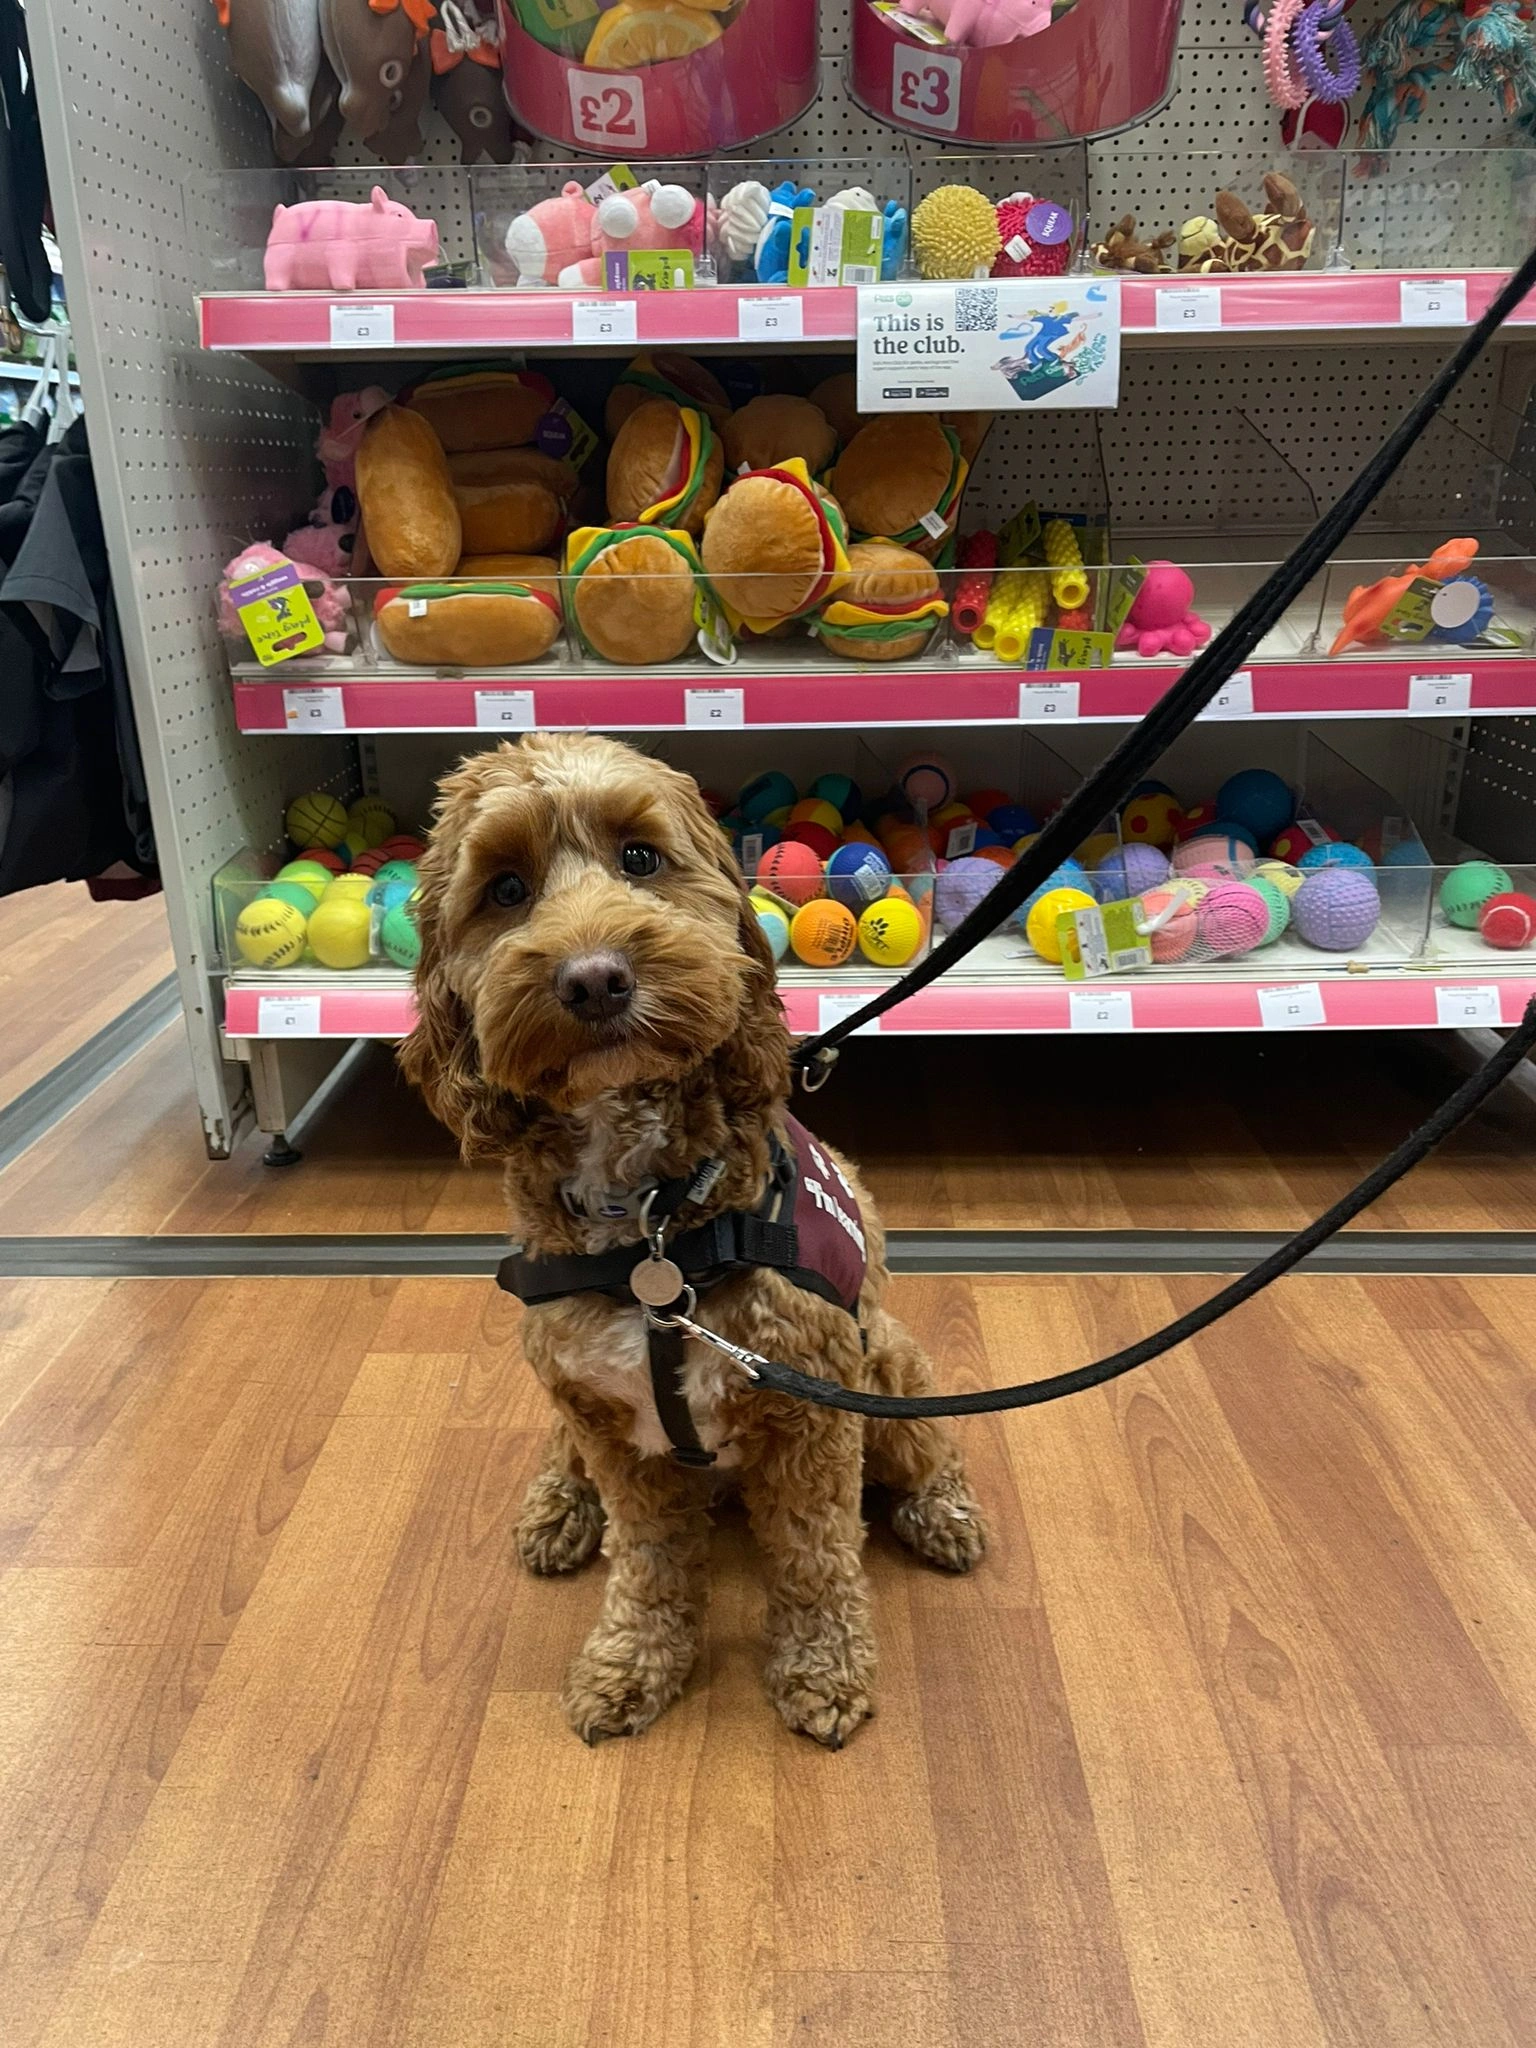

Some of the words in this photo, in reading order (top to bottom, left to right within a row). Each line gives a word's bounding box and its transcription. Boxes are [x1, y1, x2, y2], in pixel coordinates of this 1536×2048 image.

[900, 66, 950, 116] £3
[580, 87, 636, 136] £2
[1041, 211, 1059, 238] SQUEAK
[873, 313, 920, 332] This
[926, 313, 944, 331] is
[873, 336, 908, 355] the
[913, 334, 965, 354] club.
